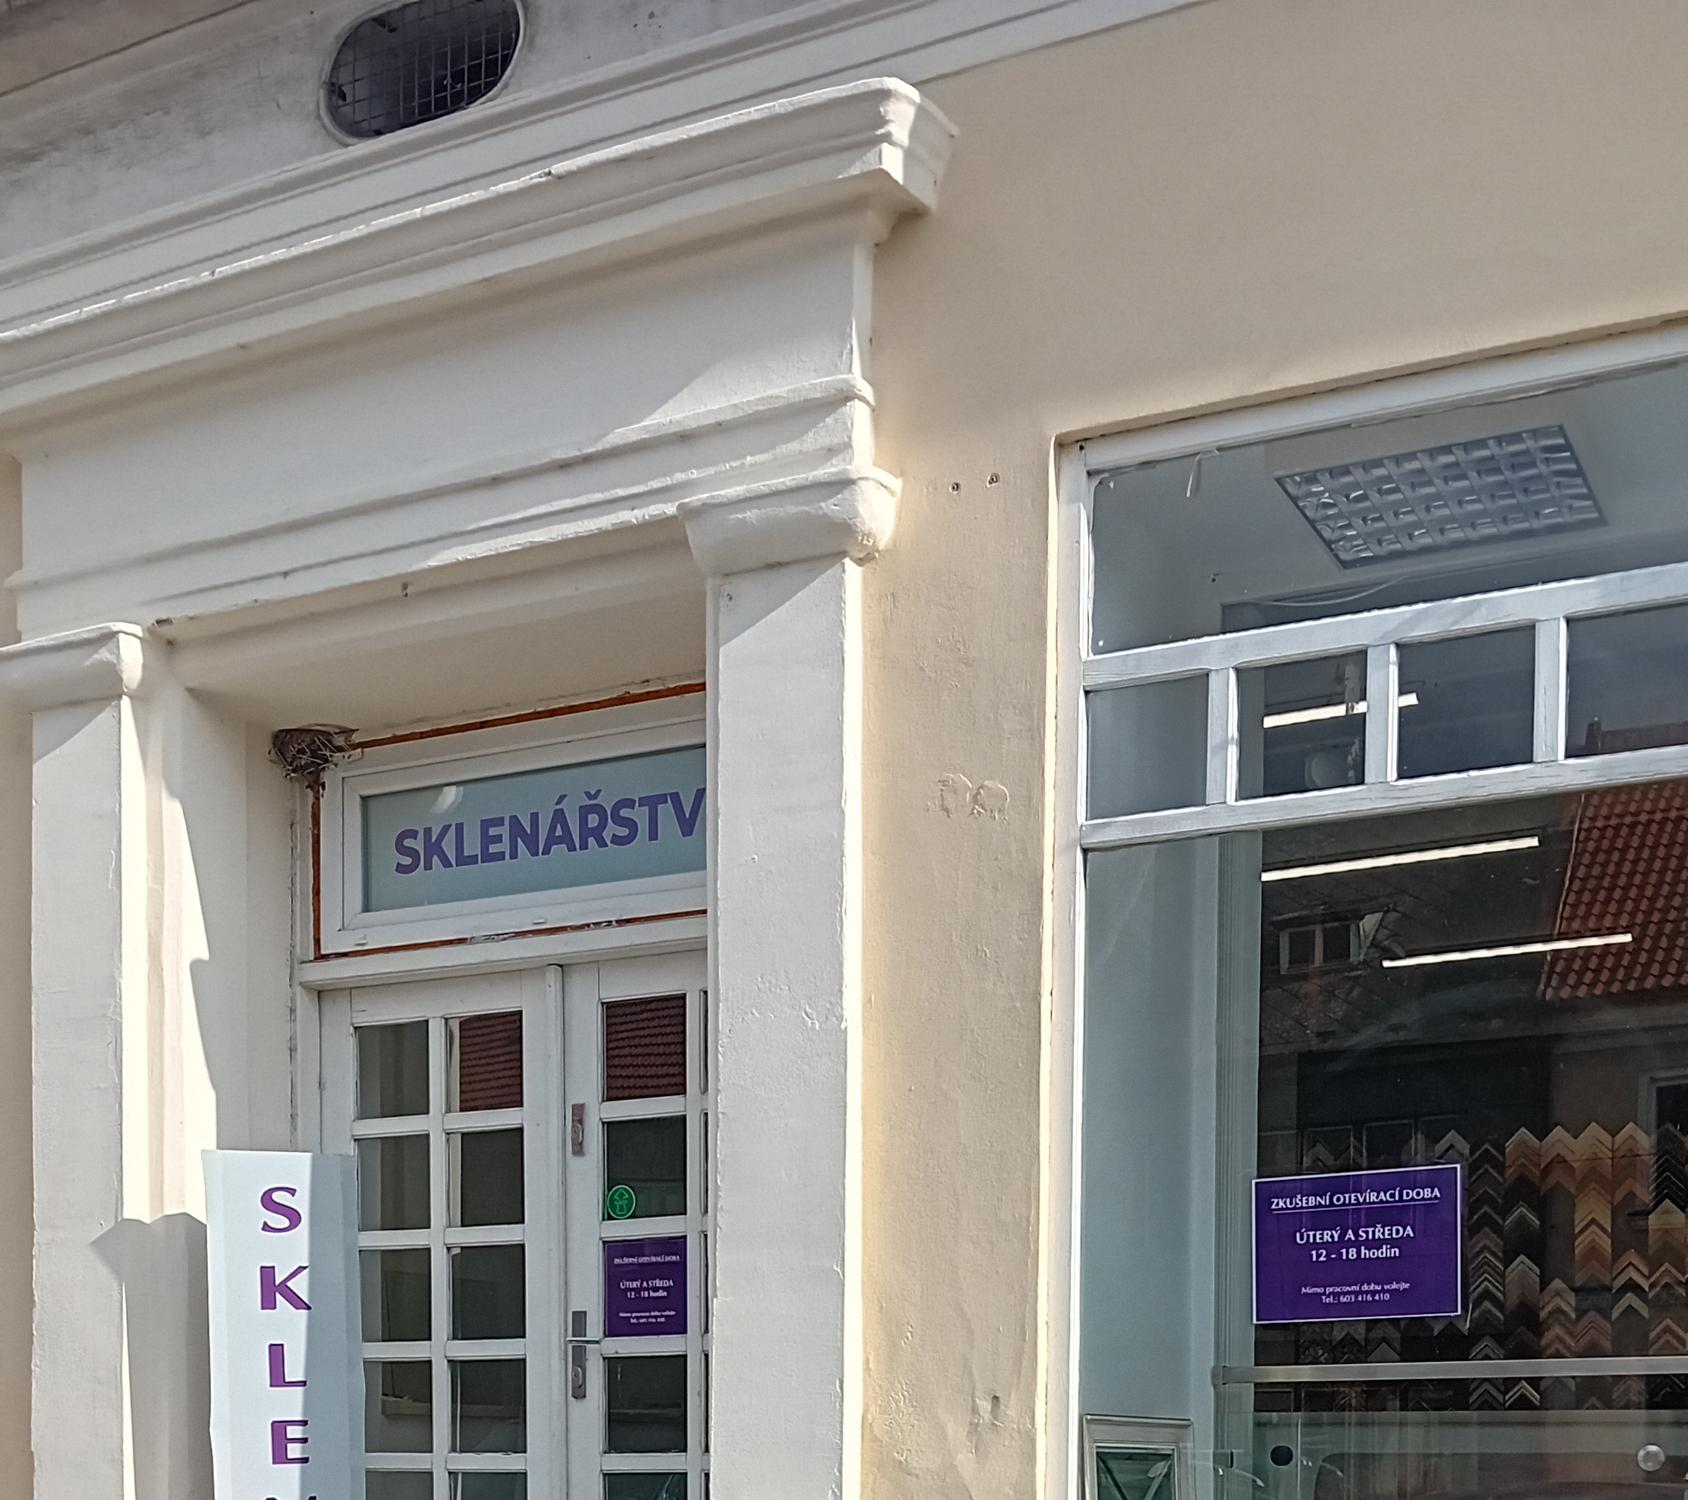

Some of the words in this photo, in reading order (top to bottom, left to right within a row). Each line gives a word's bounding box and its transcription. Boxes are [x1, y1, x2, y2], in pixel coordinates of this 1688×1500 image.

[394, 787, 706, 875] SKLENÁŘSTV
[1271, 1192, 1330, 1209] ZKUŠEBNÍ
[1333, 1187, 1399, 1205] OTEVÍRACÍ
[1402, 1187, 1441, 1200] DOBA
[1296, 1226, 1341, 1244] ÚTERÝ
[1344, 1228, 1356, 1241] A
[1358, 1223, 1414, 1240] STŘEDA
[1310, 1249, 1327, 1262] 12
[1340, 1247, 1357, 1260] 18
[1360, 1244, 1400, 1259] hodin
[1326, 1283, 1360, 1295] pracovní
[1361, 1282, 1382, 1292] dobu
[1384, 1281, 1411, 1292] volejte
